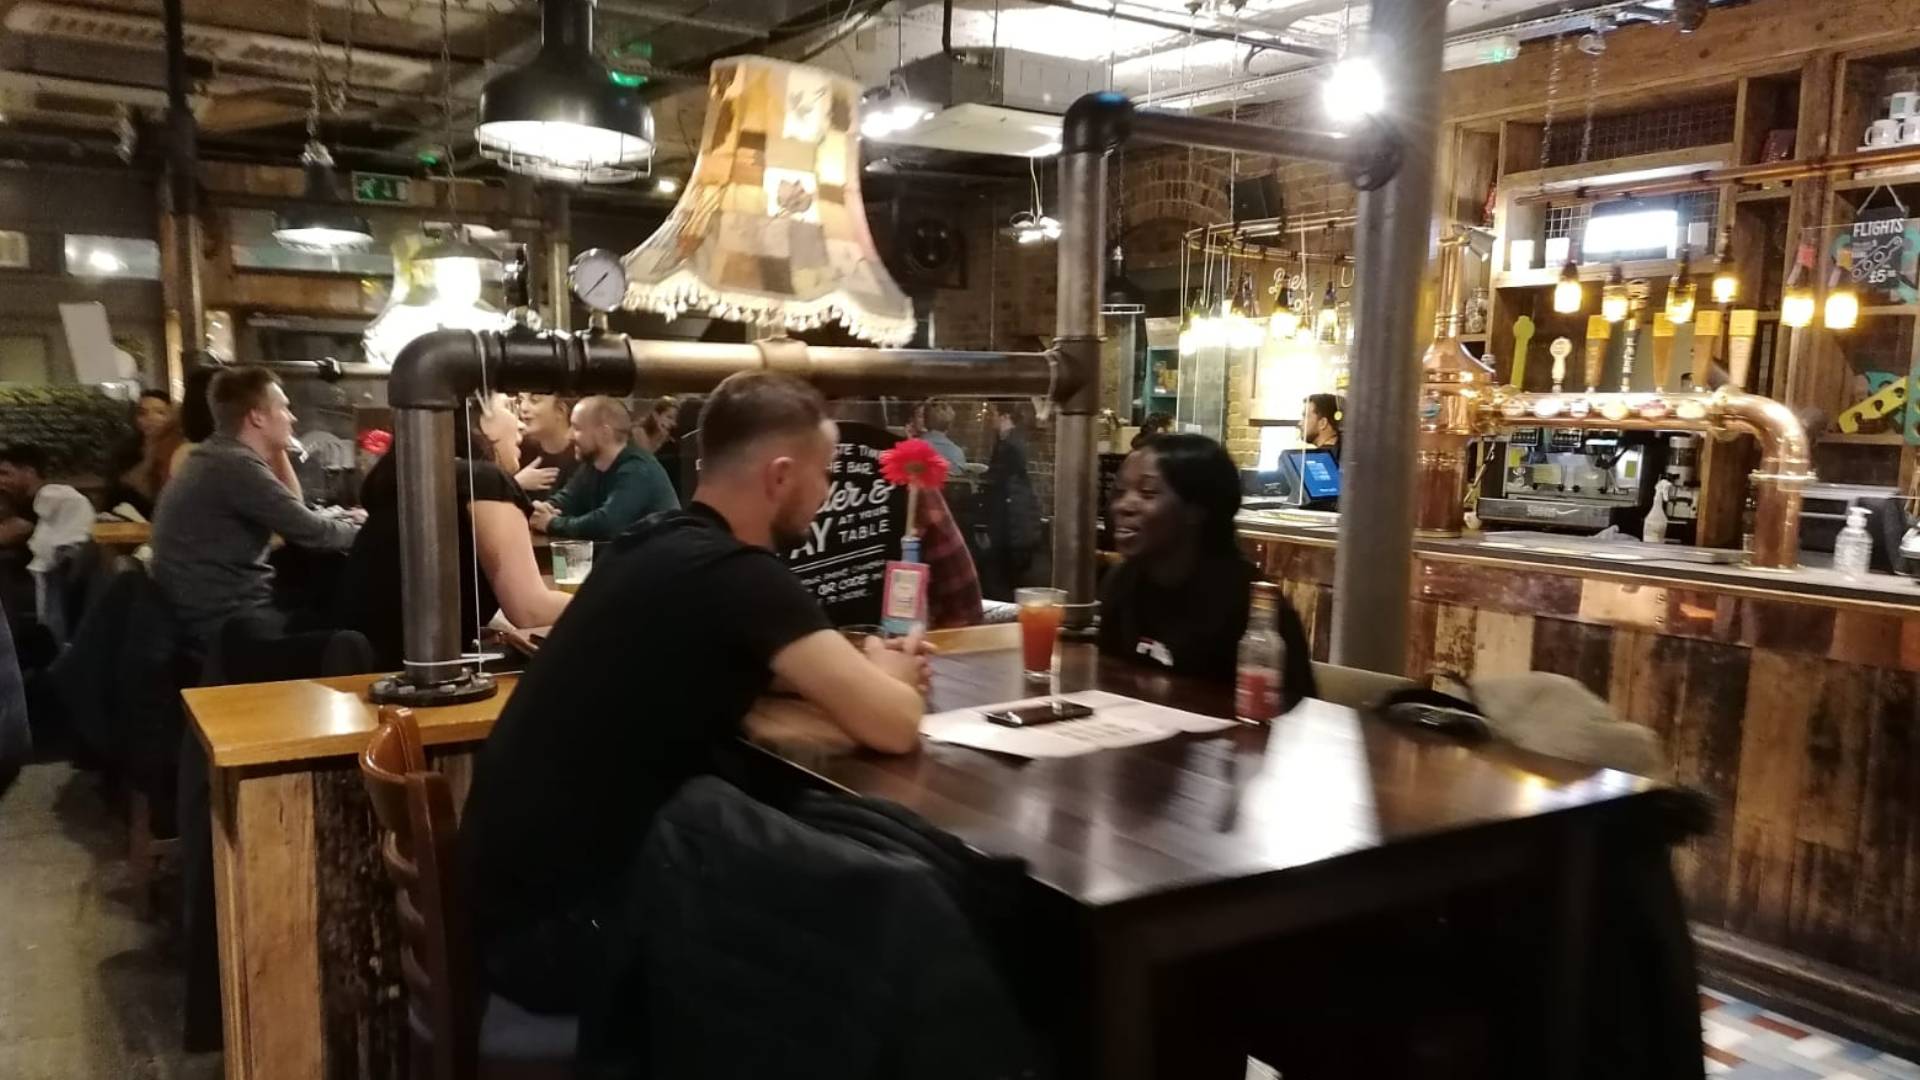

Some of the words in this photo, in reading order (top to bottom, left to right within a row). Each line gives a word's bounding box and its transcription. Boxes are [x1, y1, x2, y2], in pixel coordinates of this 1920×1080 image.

[1853, 218, 1904, 237] FLIGHTS
[847, 461, 874, 475] BAR
[838, 514, 855, 526] AT
[859, 505, 890, 520] YOUR
[838, 519, 891, 544] TABLE
